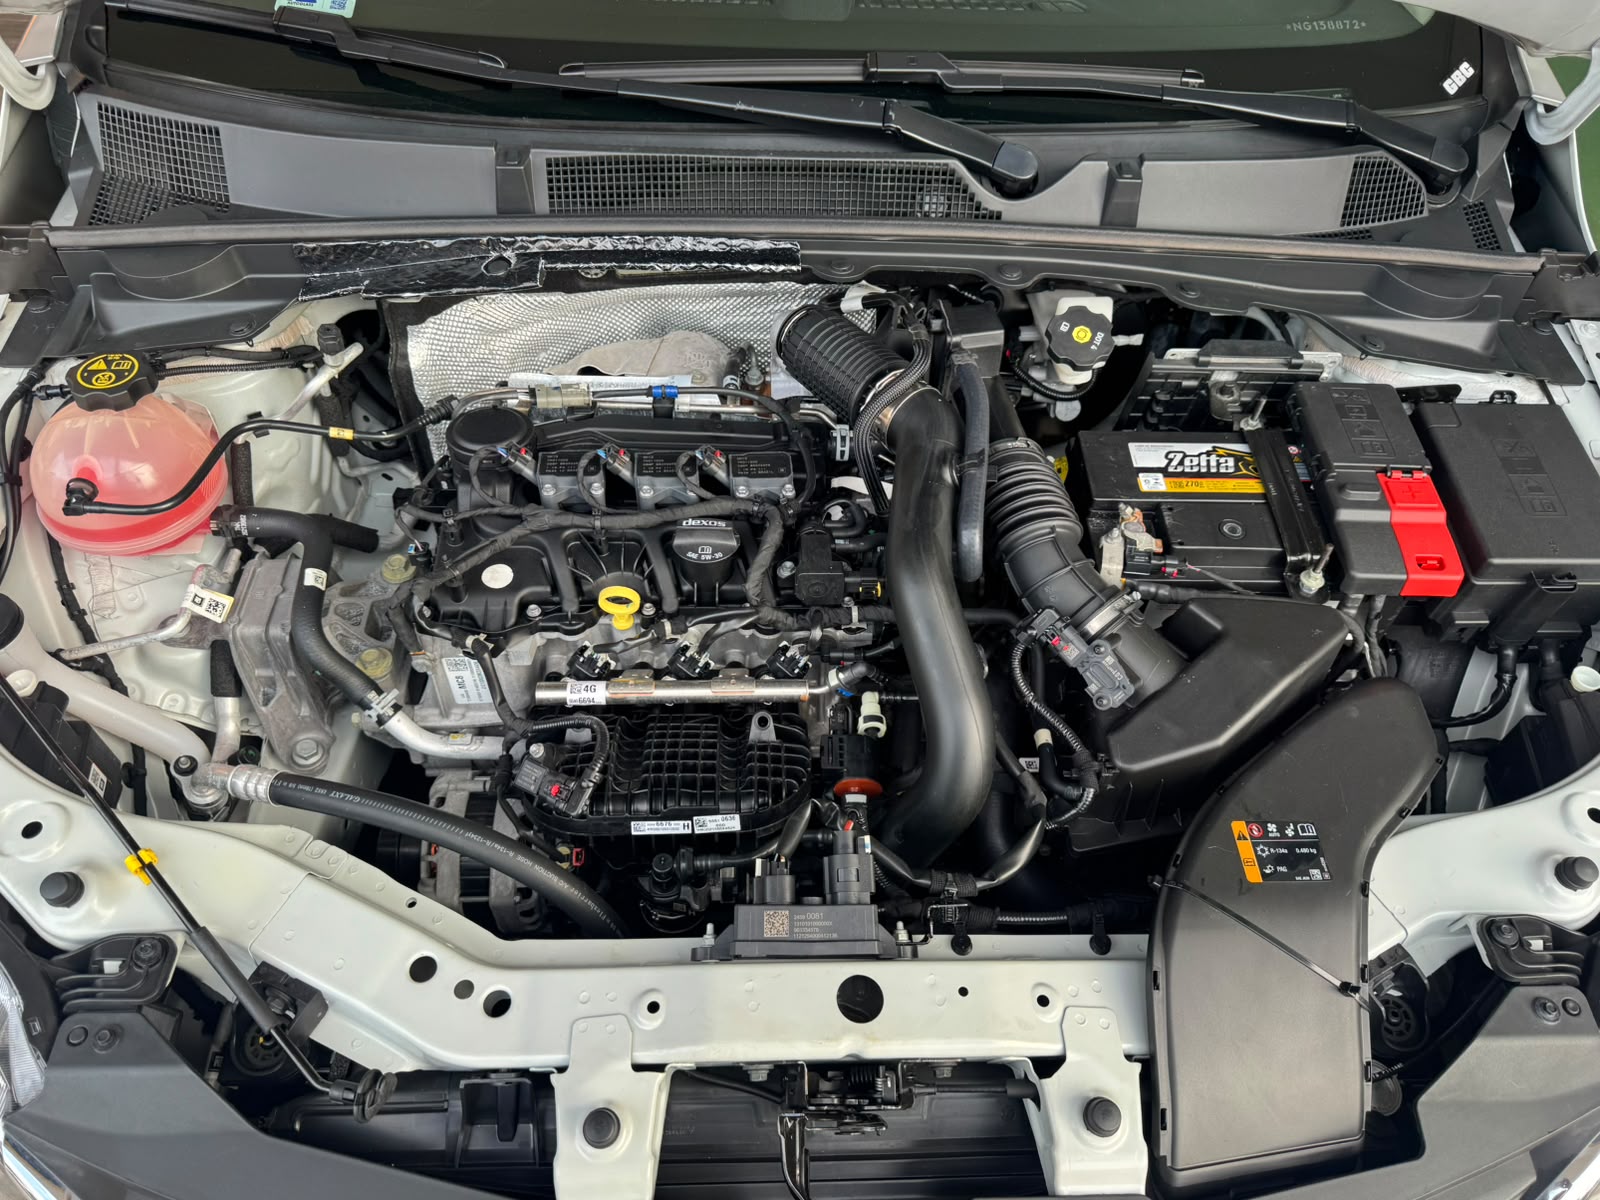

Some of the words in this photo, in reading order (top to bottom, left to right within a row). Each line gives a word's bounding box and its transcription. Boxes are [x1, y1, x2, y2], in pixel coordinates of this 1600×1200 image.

[1095, 331, 1105, 346] DOT
[1166, 450, 1235, 473] Zetta
[682, 518, 726, 527] dexos
[583, 684, 597, 693] 4G
[329, 790, 361, 804] GALAXY
[682, 822, 690, 831] H
[515, 855, 533, 867] HOSE
[533, 864, 559, 883] SUCTION
